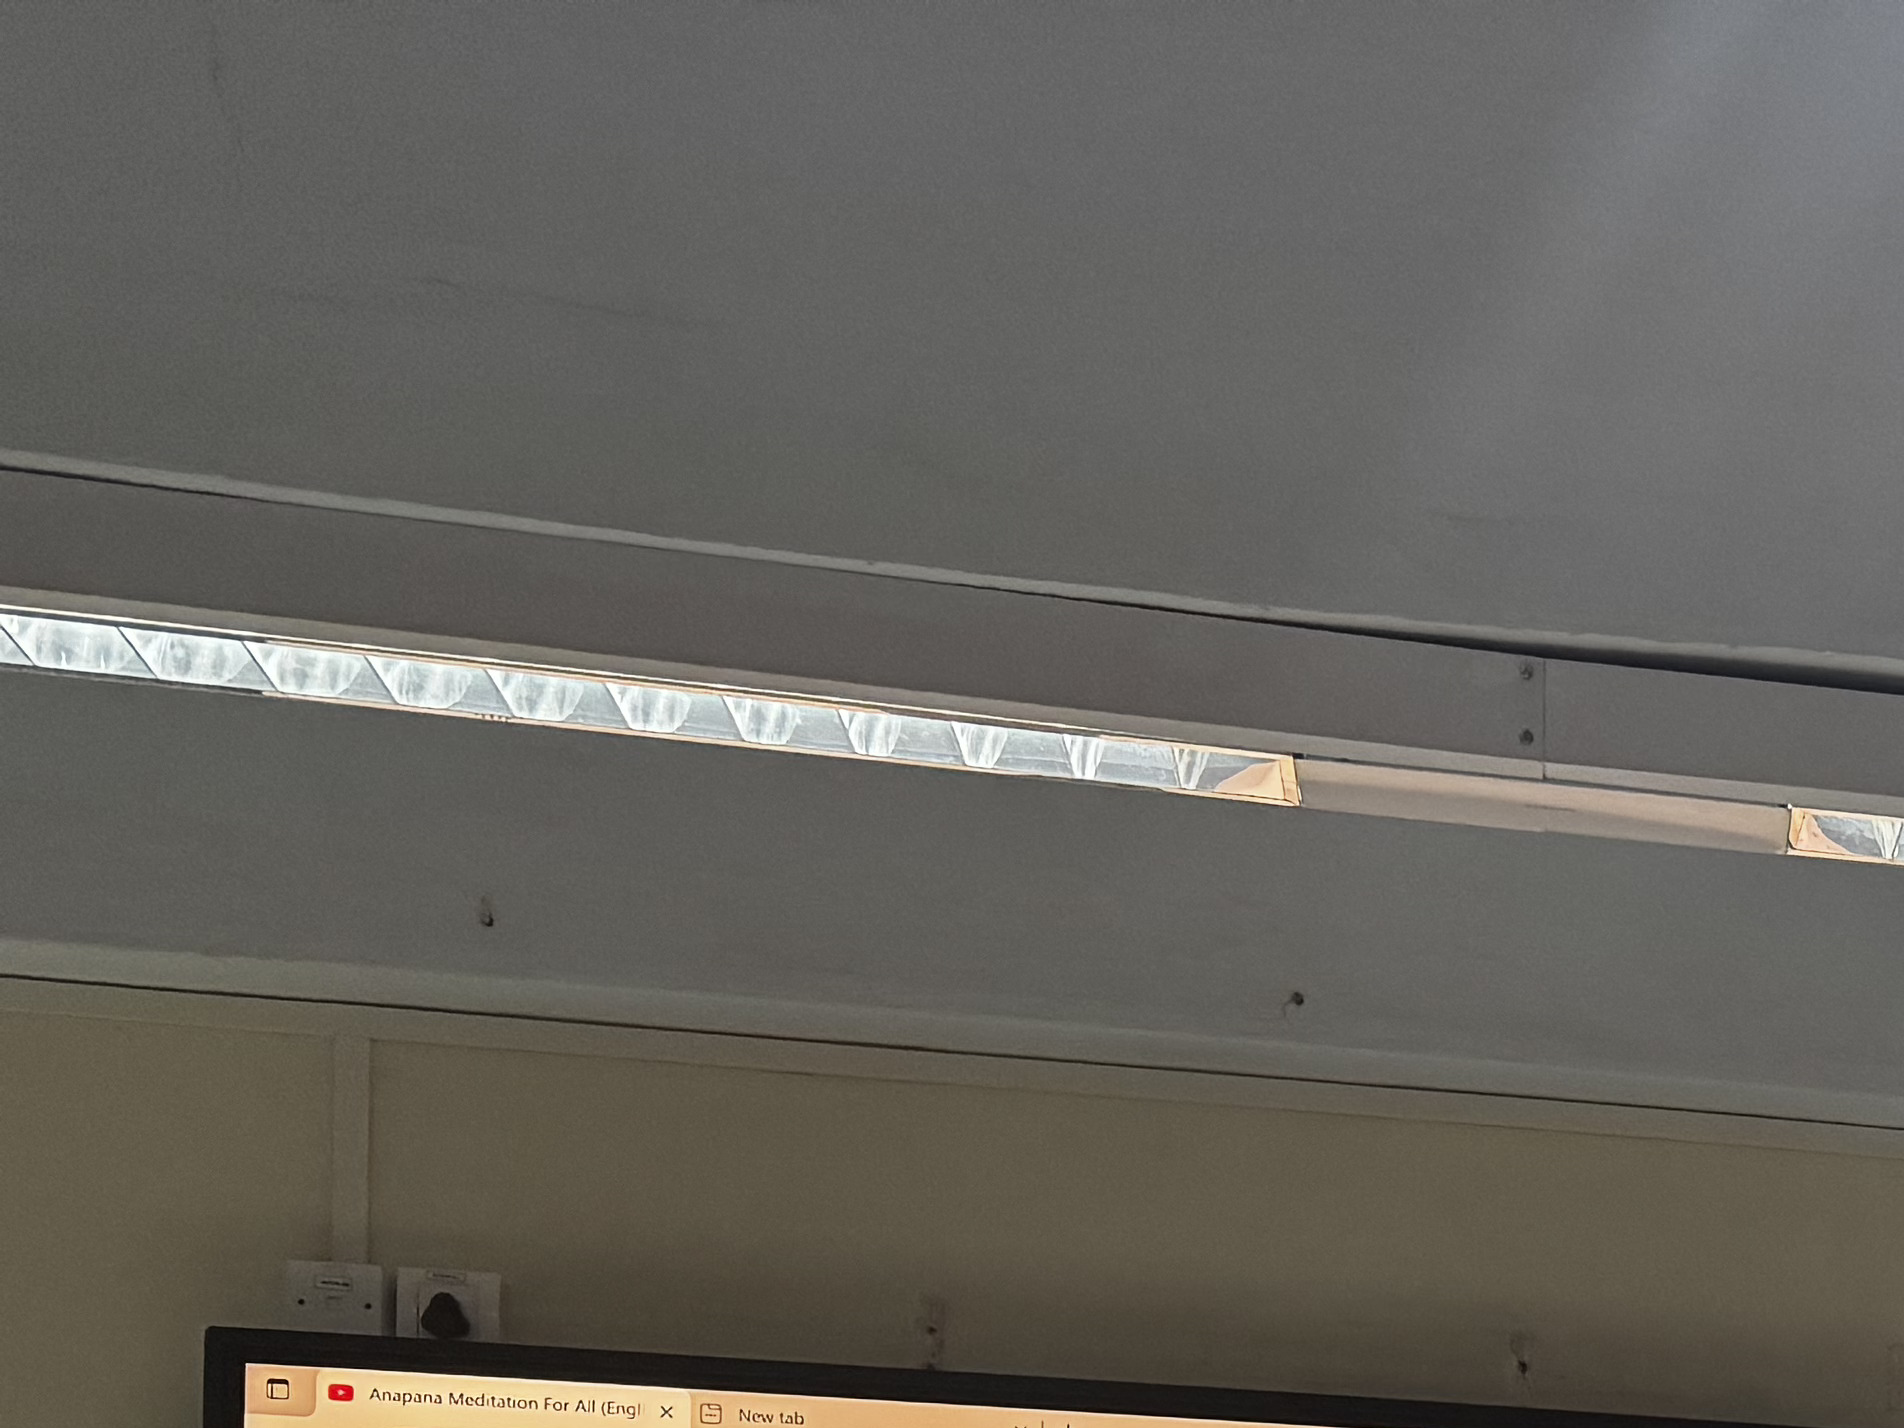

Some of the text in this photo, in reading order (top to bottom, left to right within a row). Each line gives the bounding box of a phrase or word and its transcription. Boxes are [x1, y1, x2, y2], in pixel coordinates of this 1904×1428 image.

[369, 1387, 443, 1406] Anapana
[448, 1391, 539, 1411] Meditation
[543, 1396, 570, 1413] For
[575, 1398, 597, 1414] All
[738, 1408, 805, 1426] New tab
